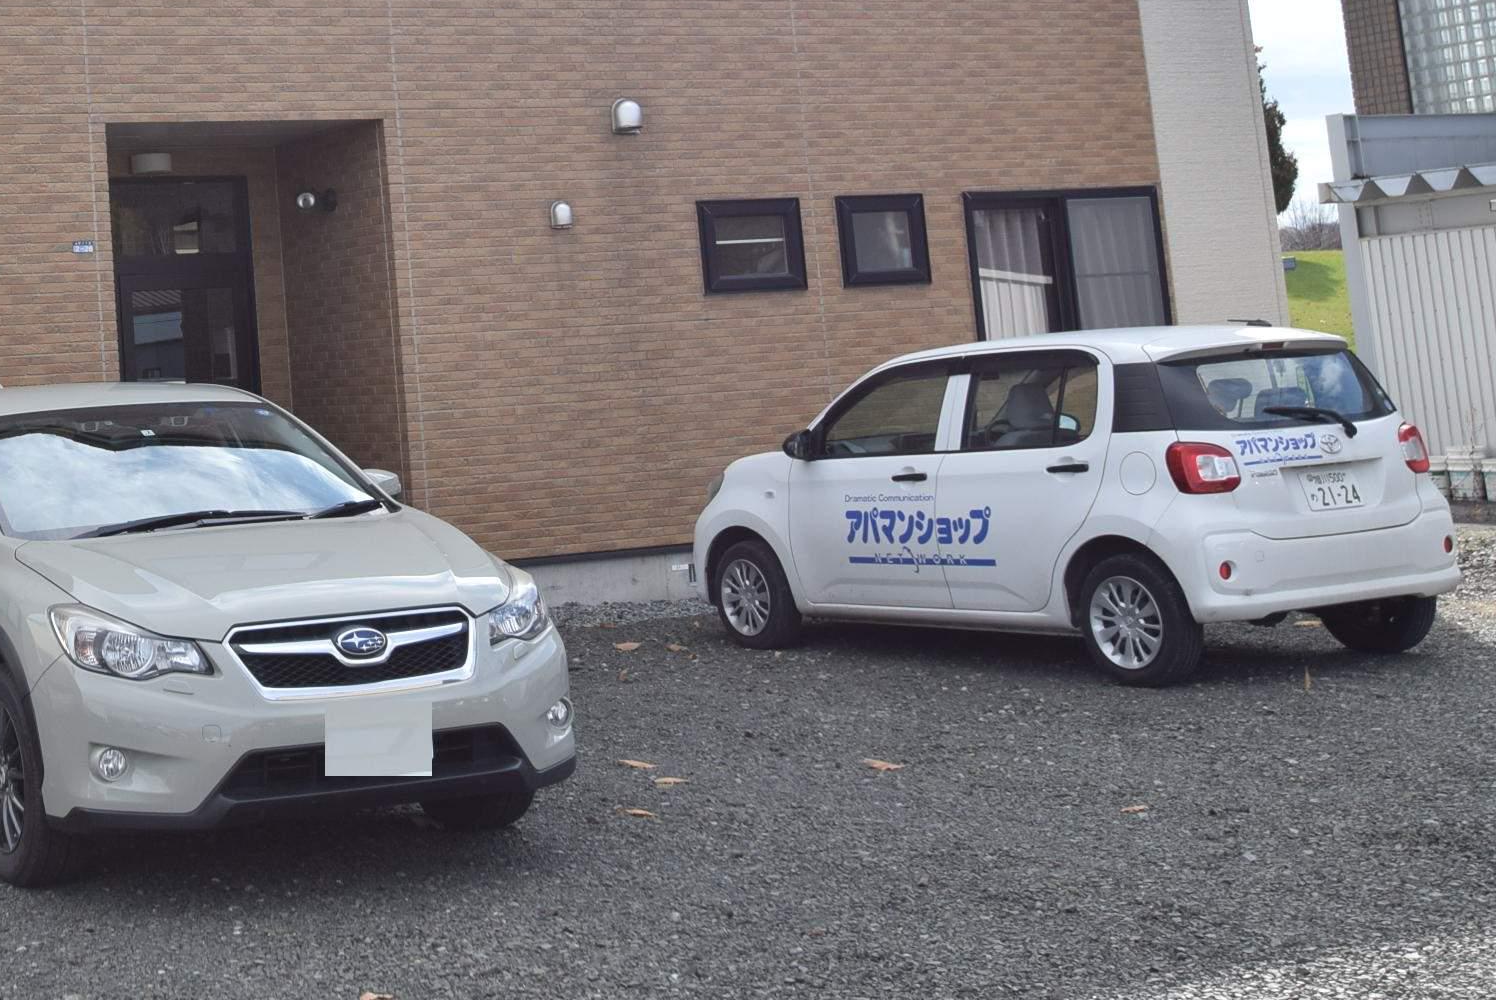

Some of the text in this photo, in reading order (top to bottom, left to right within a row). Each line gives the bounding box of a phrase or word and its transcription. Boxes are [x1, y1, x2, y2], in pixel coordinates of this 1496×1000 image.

[844, 493, 934, 503] Dramatic Communication
[845, 506, 992, 545] アパマンショップ
